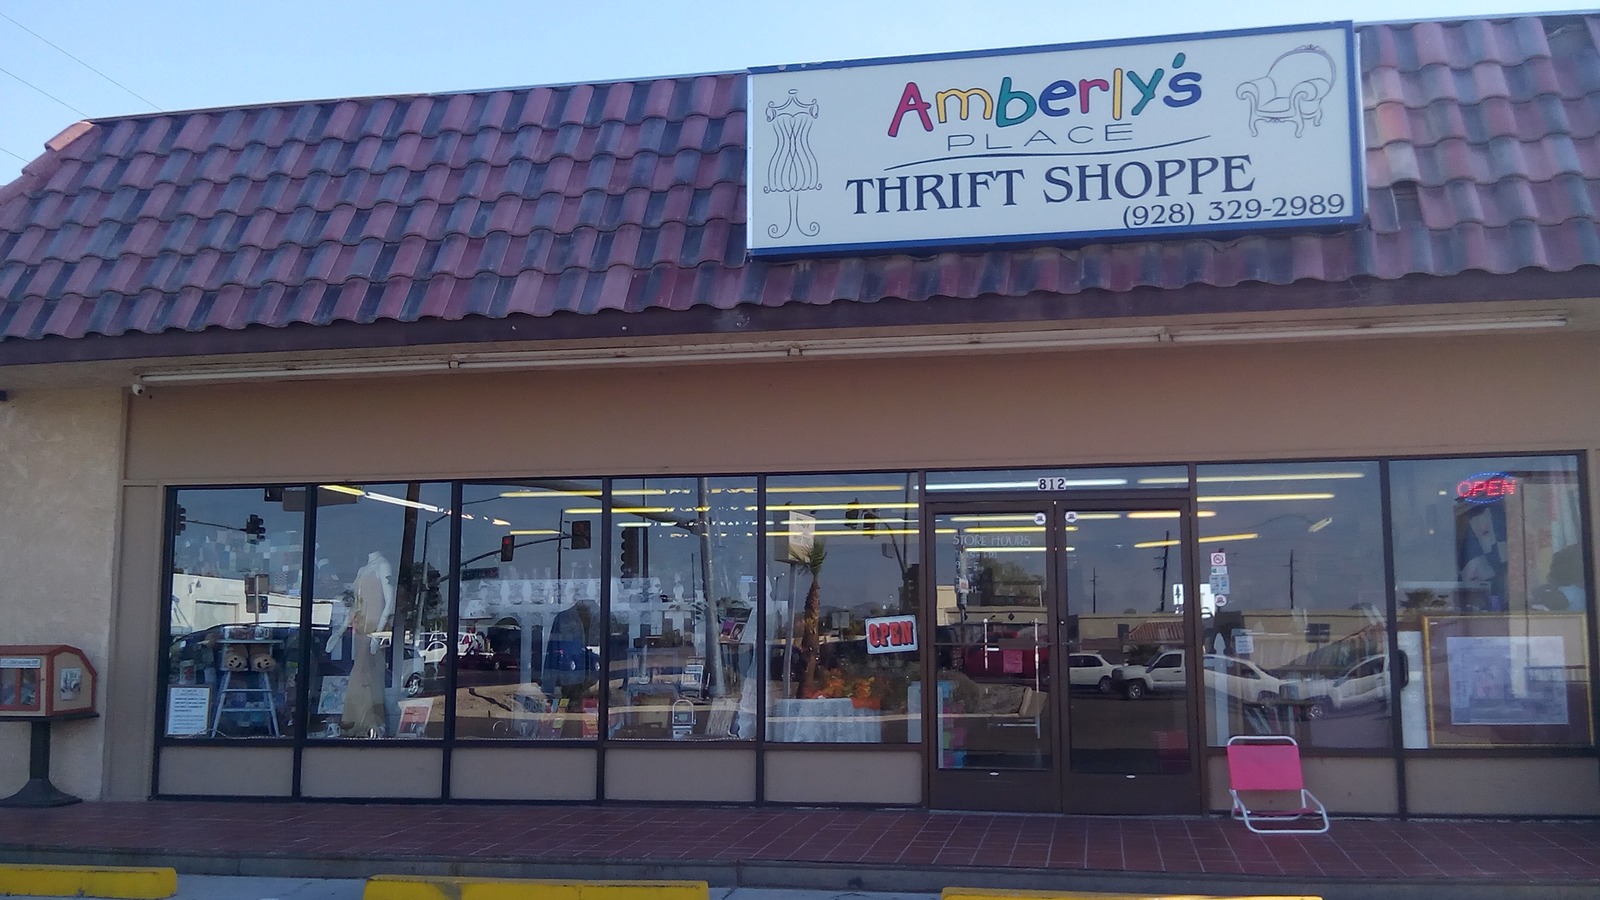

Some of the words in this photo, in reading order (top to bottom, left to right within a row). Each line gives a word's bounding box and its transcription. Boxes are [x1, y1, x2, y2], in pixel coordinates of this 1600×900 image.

[887, 51, 1203, 138] Amberly's
[947, 122, 1133, 152] PLACE
[845, 169, 1026, 215] THRIFT
[1042, 154, 1256, 204] SHOPPE
[1122, 201, 1195, 229] (928)
[1207, 193, 1345, 222] 329-2989
[1039, 478, 1065, 490] 812
[1457, 478, 1517, 497] OPEN
[953, 534, 986, 546] STORE
[991, 535, 1031, 546] HOURS
[868, 621, 914, 648] OPEN
